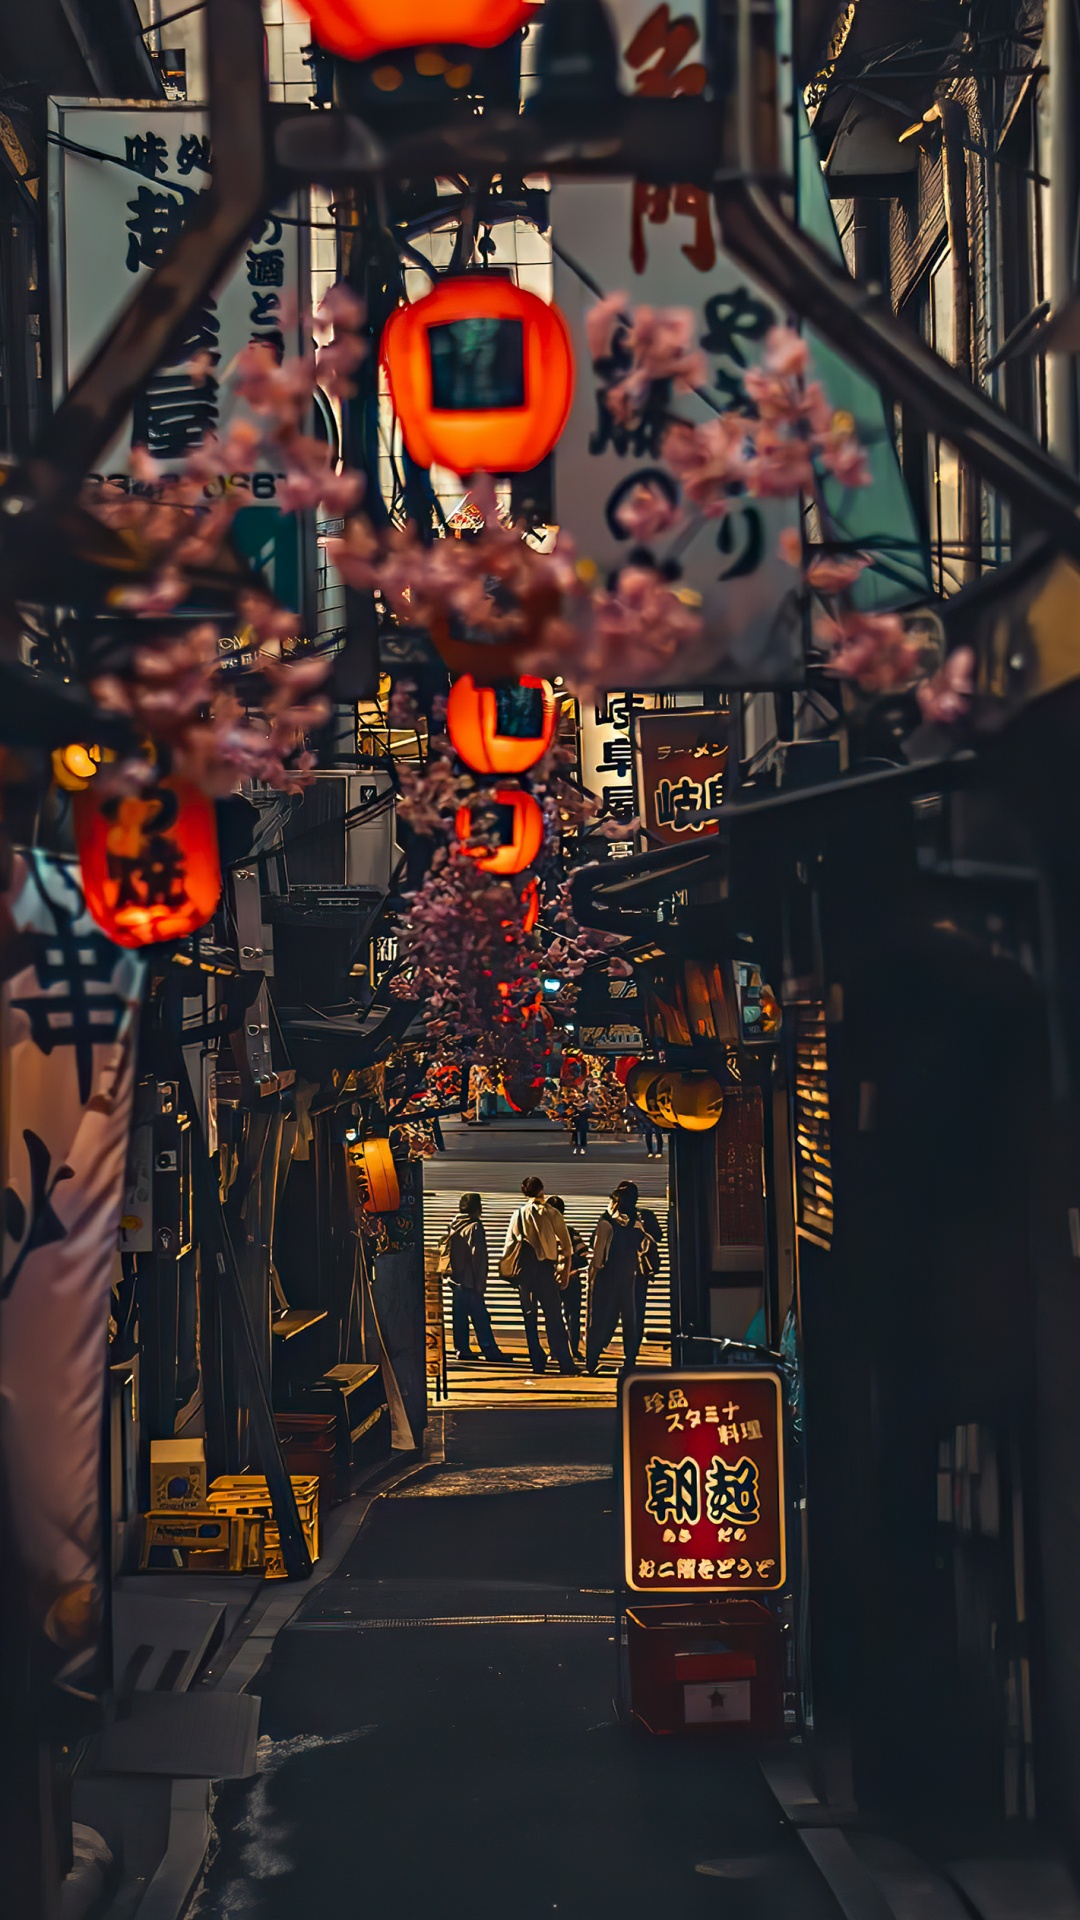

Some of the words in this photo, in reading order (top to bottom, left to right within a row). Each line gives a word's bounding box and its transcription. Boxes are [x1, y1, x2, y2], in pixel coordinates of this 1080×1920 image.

[656, 742, 729, 760] ラーメン
[664, 1400, 741, 1433] スタミナ
